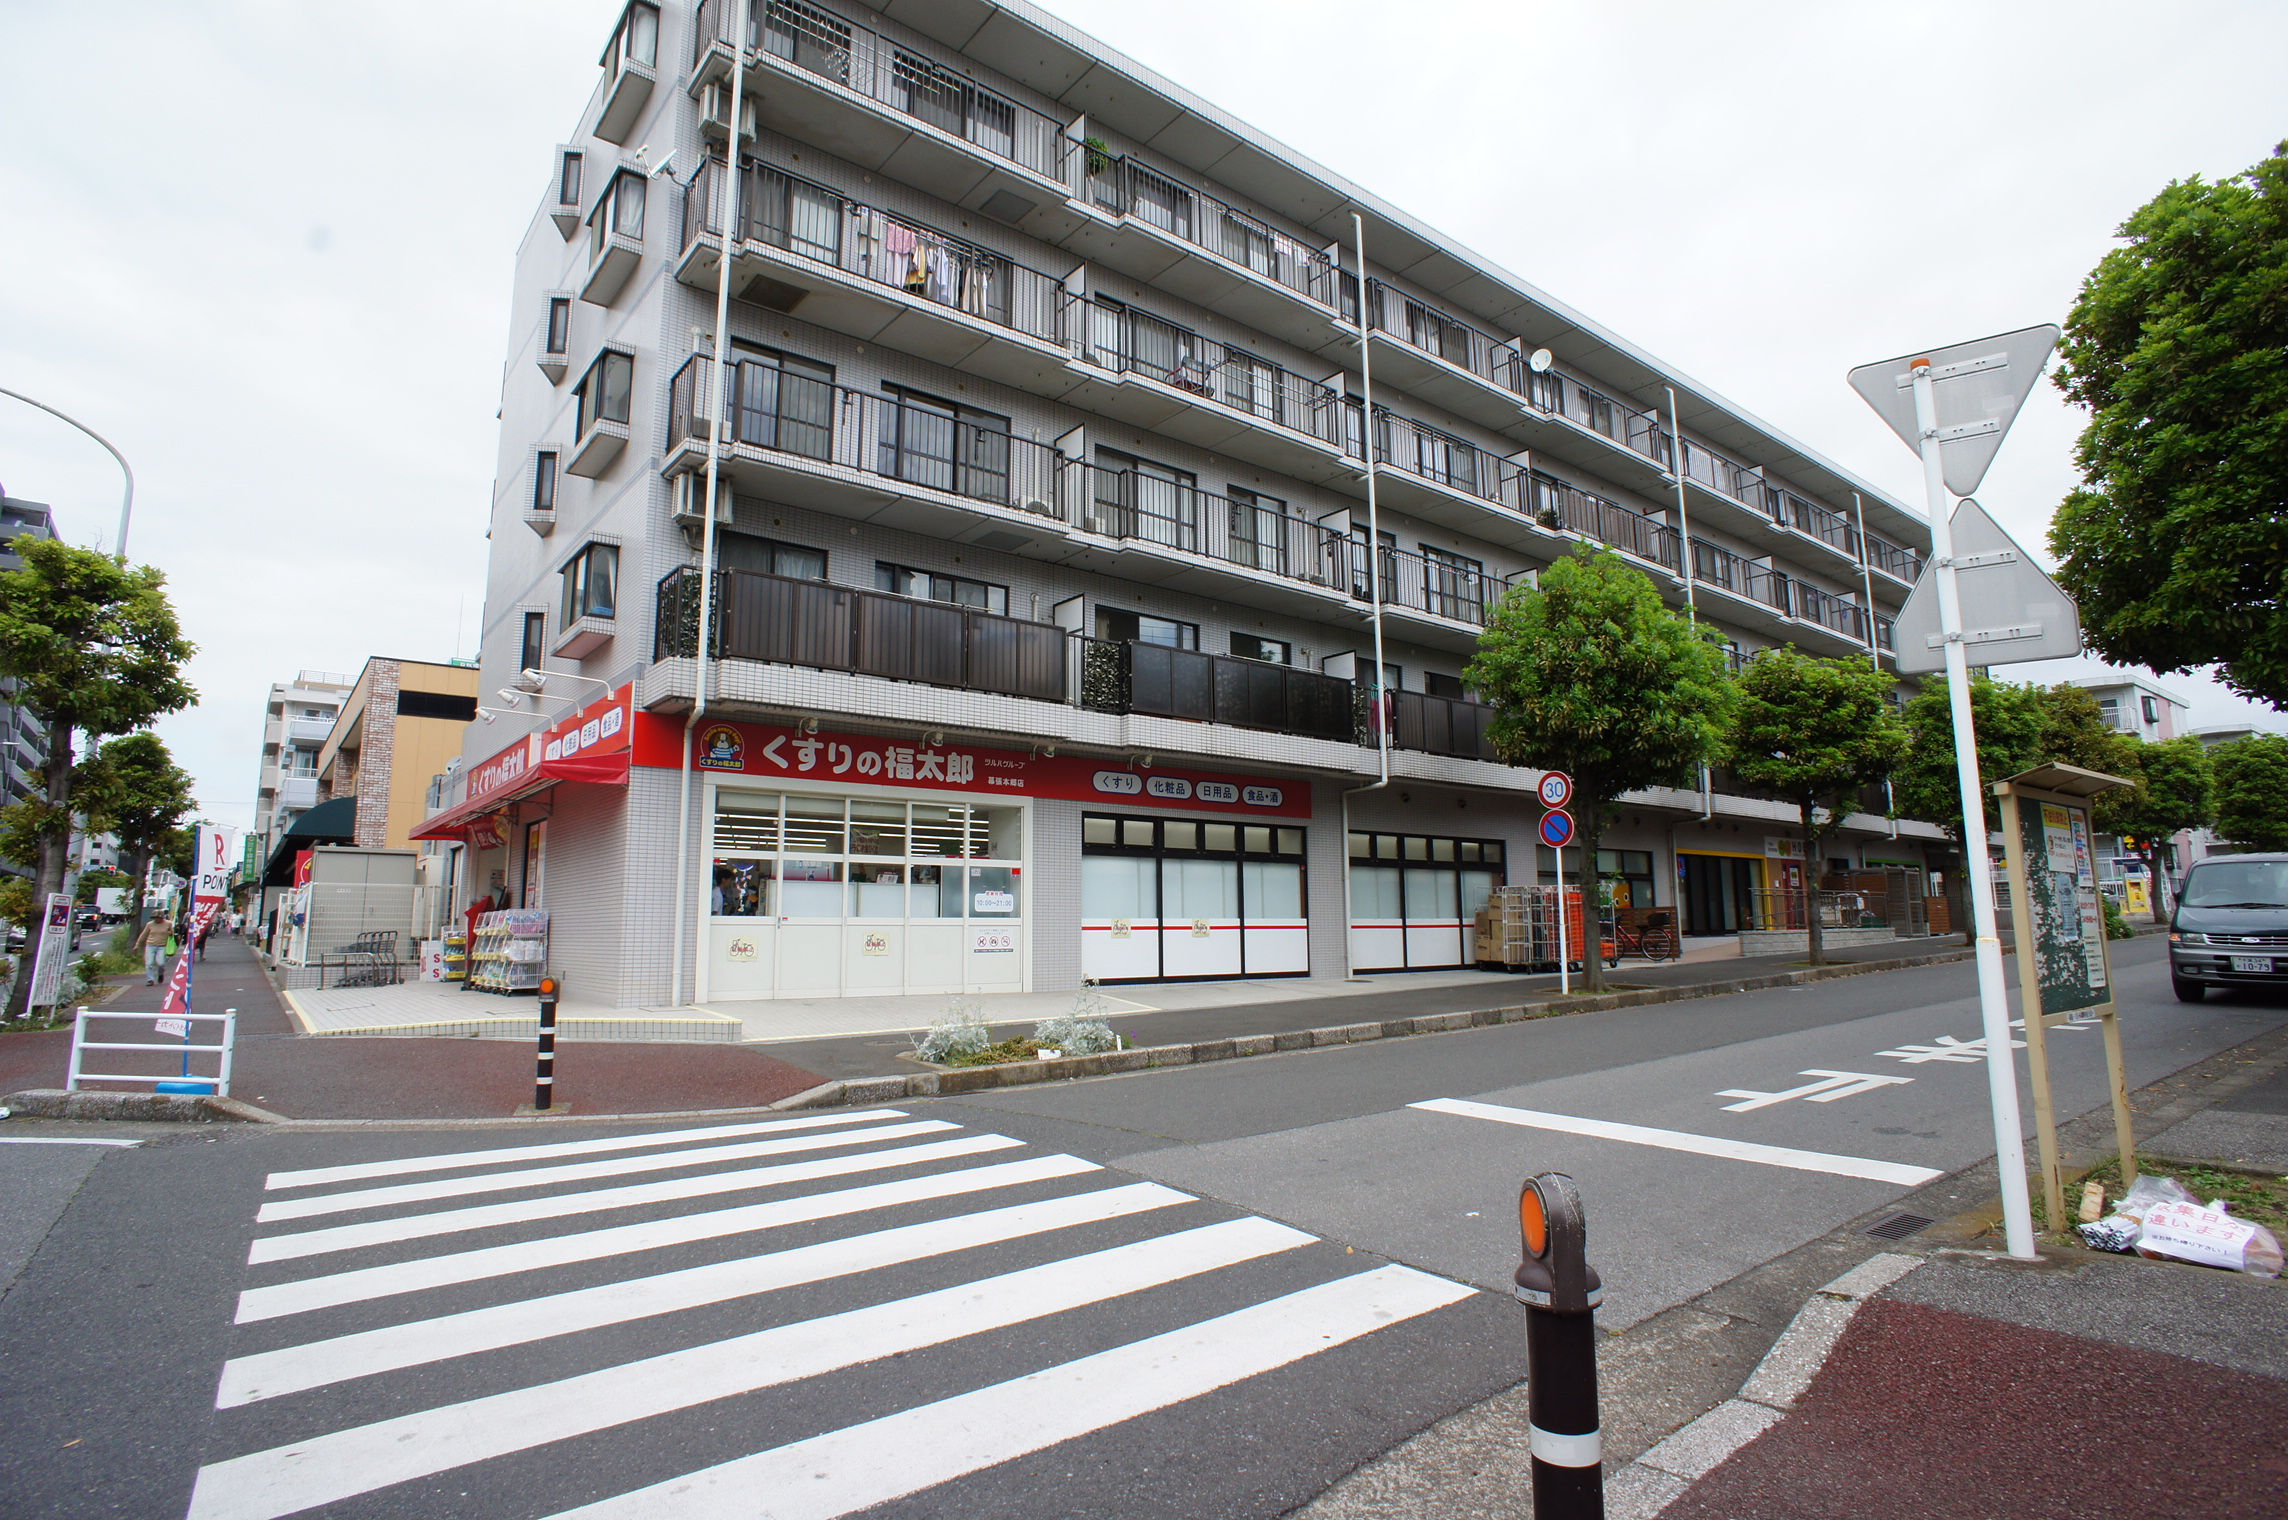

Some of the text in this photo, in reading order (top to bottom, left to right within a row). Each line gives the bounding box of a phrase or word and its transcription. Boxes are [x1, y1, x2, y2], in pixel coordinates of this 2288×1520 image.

[701, 758, 742, 768] くすりの福太郎
[762, 735, 974, 785] くすりの福太郎
[984, 758, 1026, 770] ツルハグループ
[988, 776, 1025, 788] 幕張本郷店
[1102, 776, 1134, 790] くすり
[1154, 780, 1186, 795] 化粧品
[1203, 785, 1232, 799] 日用品
[1247, 789, 1279, 803] 食品・酒
[1545, 781, 1564, 798] 30
[2148, 1213, 2241, 1240] 違います
